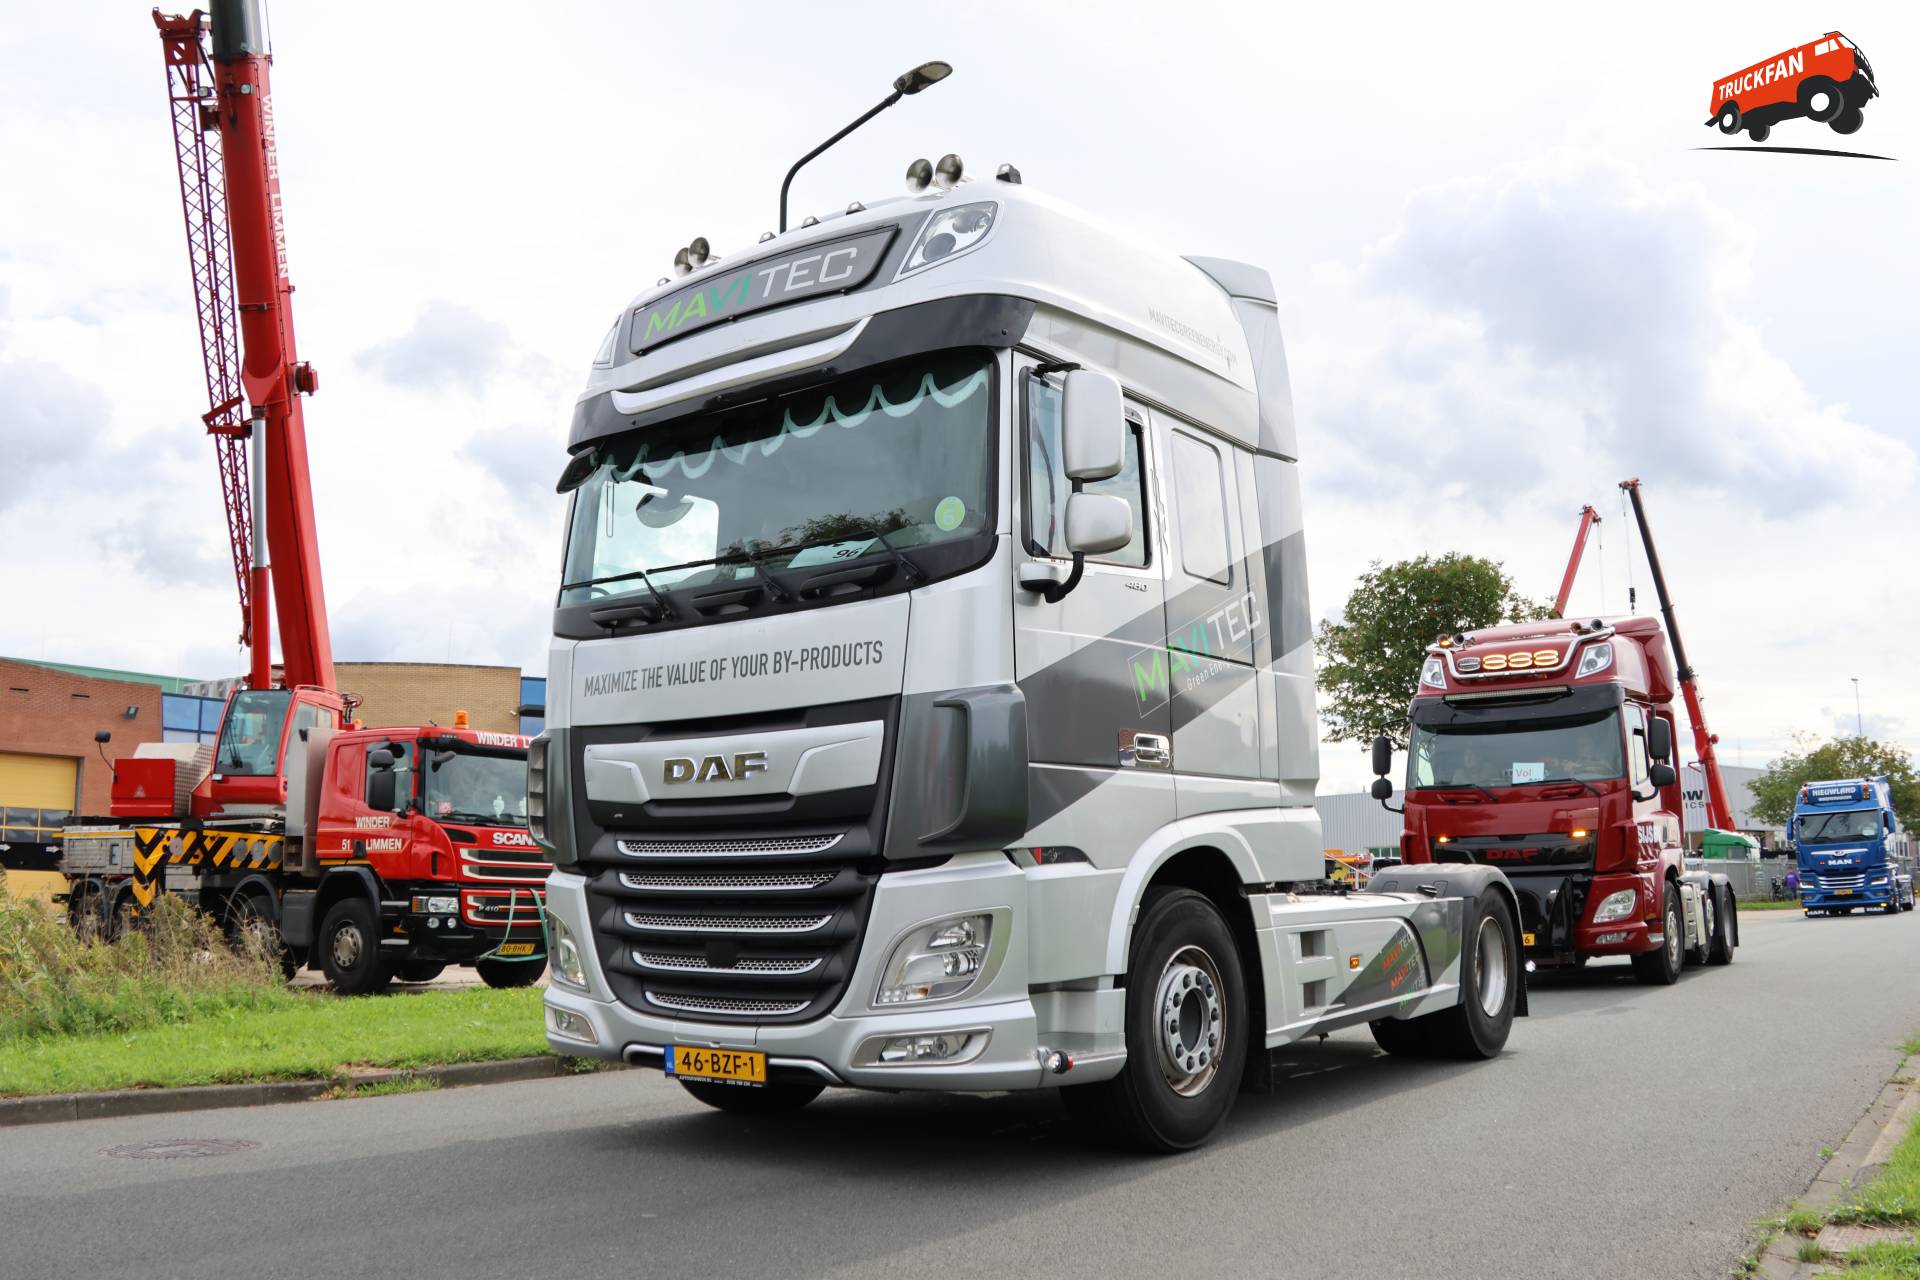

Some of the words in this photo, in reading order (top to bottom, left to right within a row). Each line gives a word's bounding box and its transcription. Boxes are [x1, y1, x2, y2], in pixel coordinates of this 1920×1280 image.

[262, 96, 279, 180] WINDER
[271, 193, 289, 279] LIMMEN
[643, 246, 857, 341] MAVITEC
[1133, 591, 1261, 702] MAVITEC
[584, 670, 638, 697] MAXIMIZE
[641, 665, 663, 689] THE
[666, 660, 707, 687] VALUE
[710, 657, 727, 681] OF
[731, 653, 768, 678] YOUR
[773, 640, 883, 673] BY-PRODUCTS
[1186, 670, 1209, 690] Green
[476, 731, 518, 748] WINDER
[663, 751, 768, 785] DAF
[1812, 786, 1856, 797] NIEUWLAND
[355, 816, 390, 828] WINDER
[365, 838, 402, 850] LIMMEN
[492, 832, 537, 846] SCAN
[1486, 848, 1538, 861] DAF
[682, 1051, 754, 1076] 46-BZF-1
